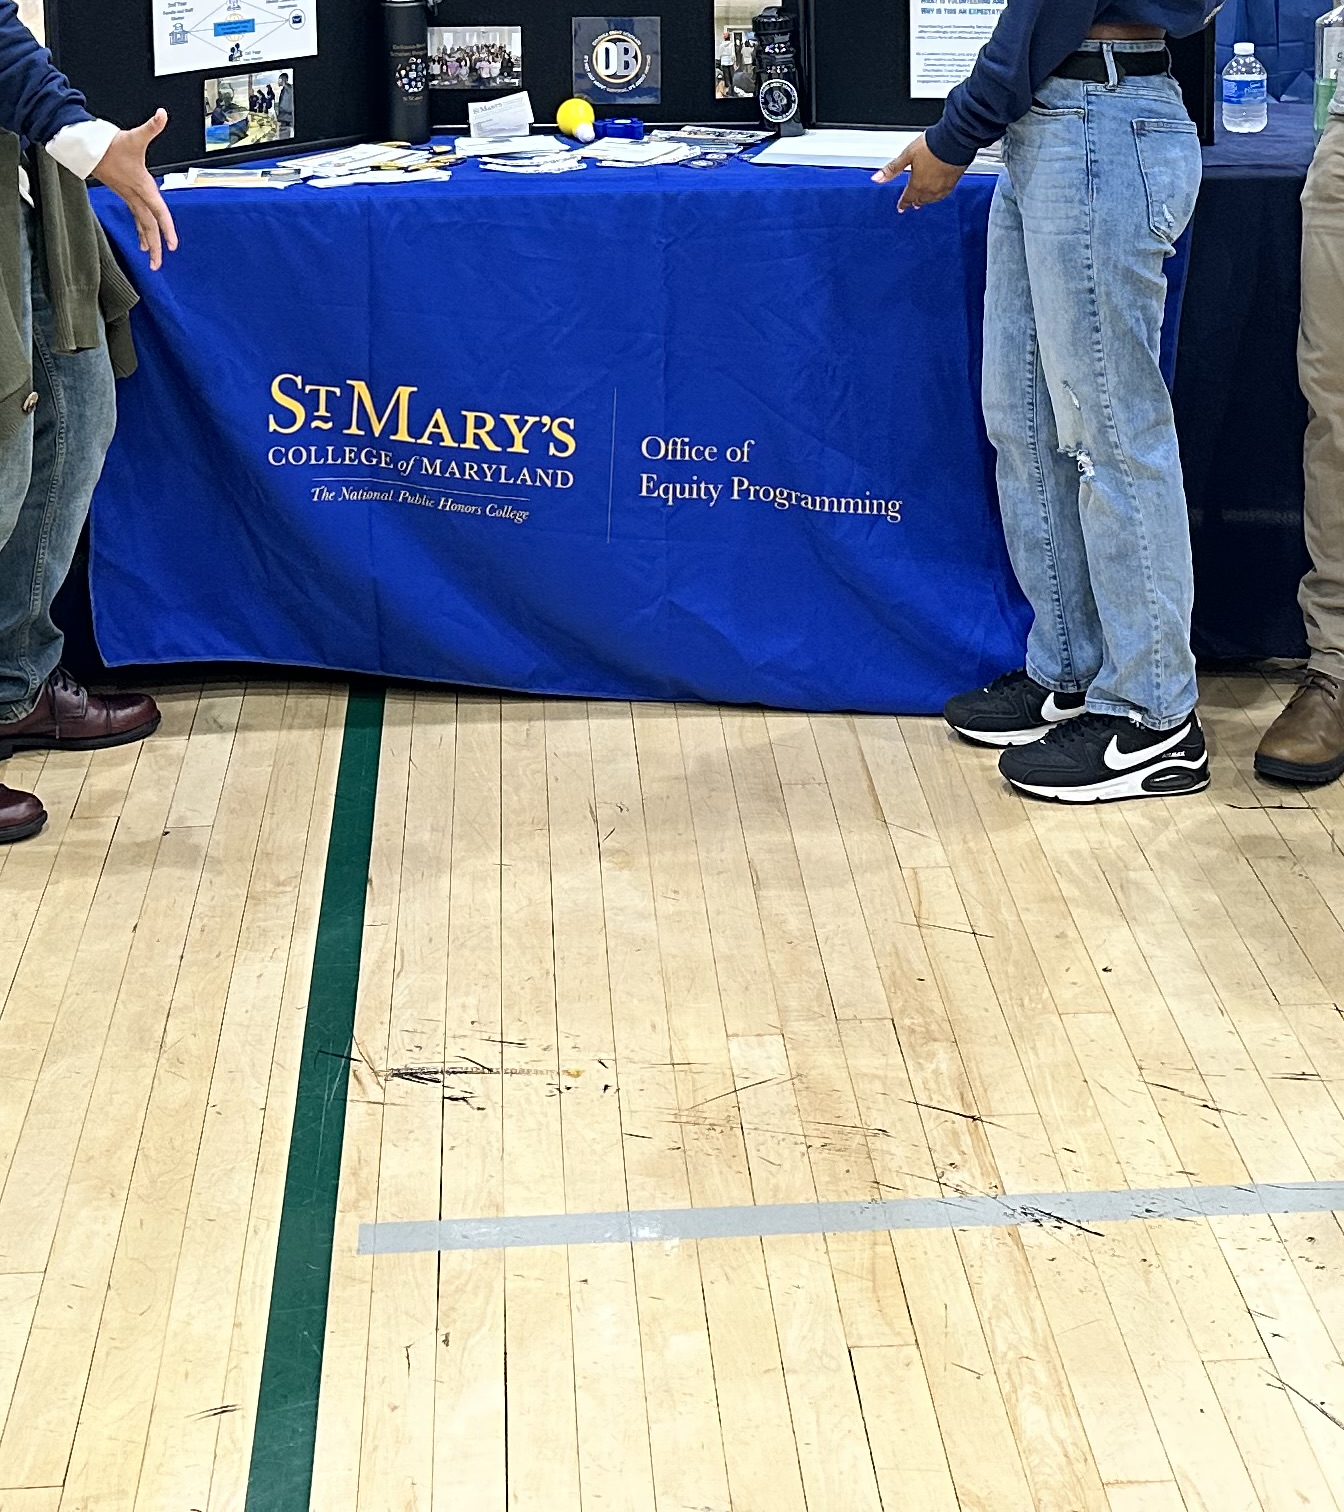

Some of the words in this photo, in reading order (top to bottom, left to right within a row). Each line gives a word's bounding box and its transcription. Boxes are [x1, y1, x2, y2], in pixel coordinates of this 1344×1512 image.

[343, 379, 576, 458] MARY'S
[268, 446, 393, 468] COLLEGE
[397, 455, 420, 476] of
[420, 457, 574, 489] MARYLAND
[641, 435, 718, 461] Office
[725, 440, 755, 462] of
[311, 486, 335, 502] The
[338, 486, 393, 502] National
[397, 490, 435, 508] Public
[438, 497, 482, 515] Honors
[485, 504, 530, 524] College
[639, 473, 723, 507] Equity
[730, 477, 902, 523] Programming
